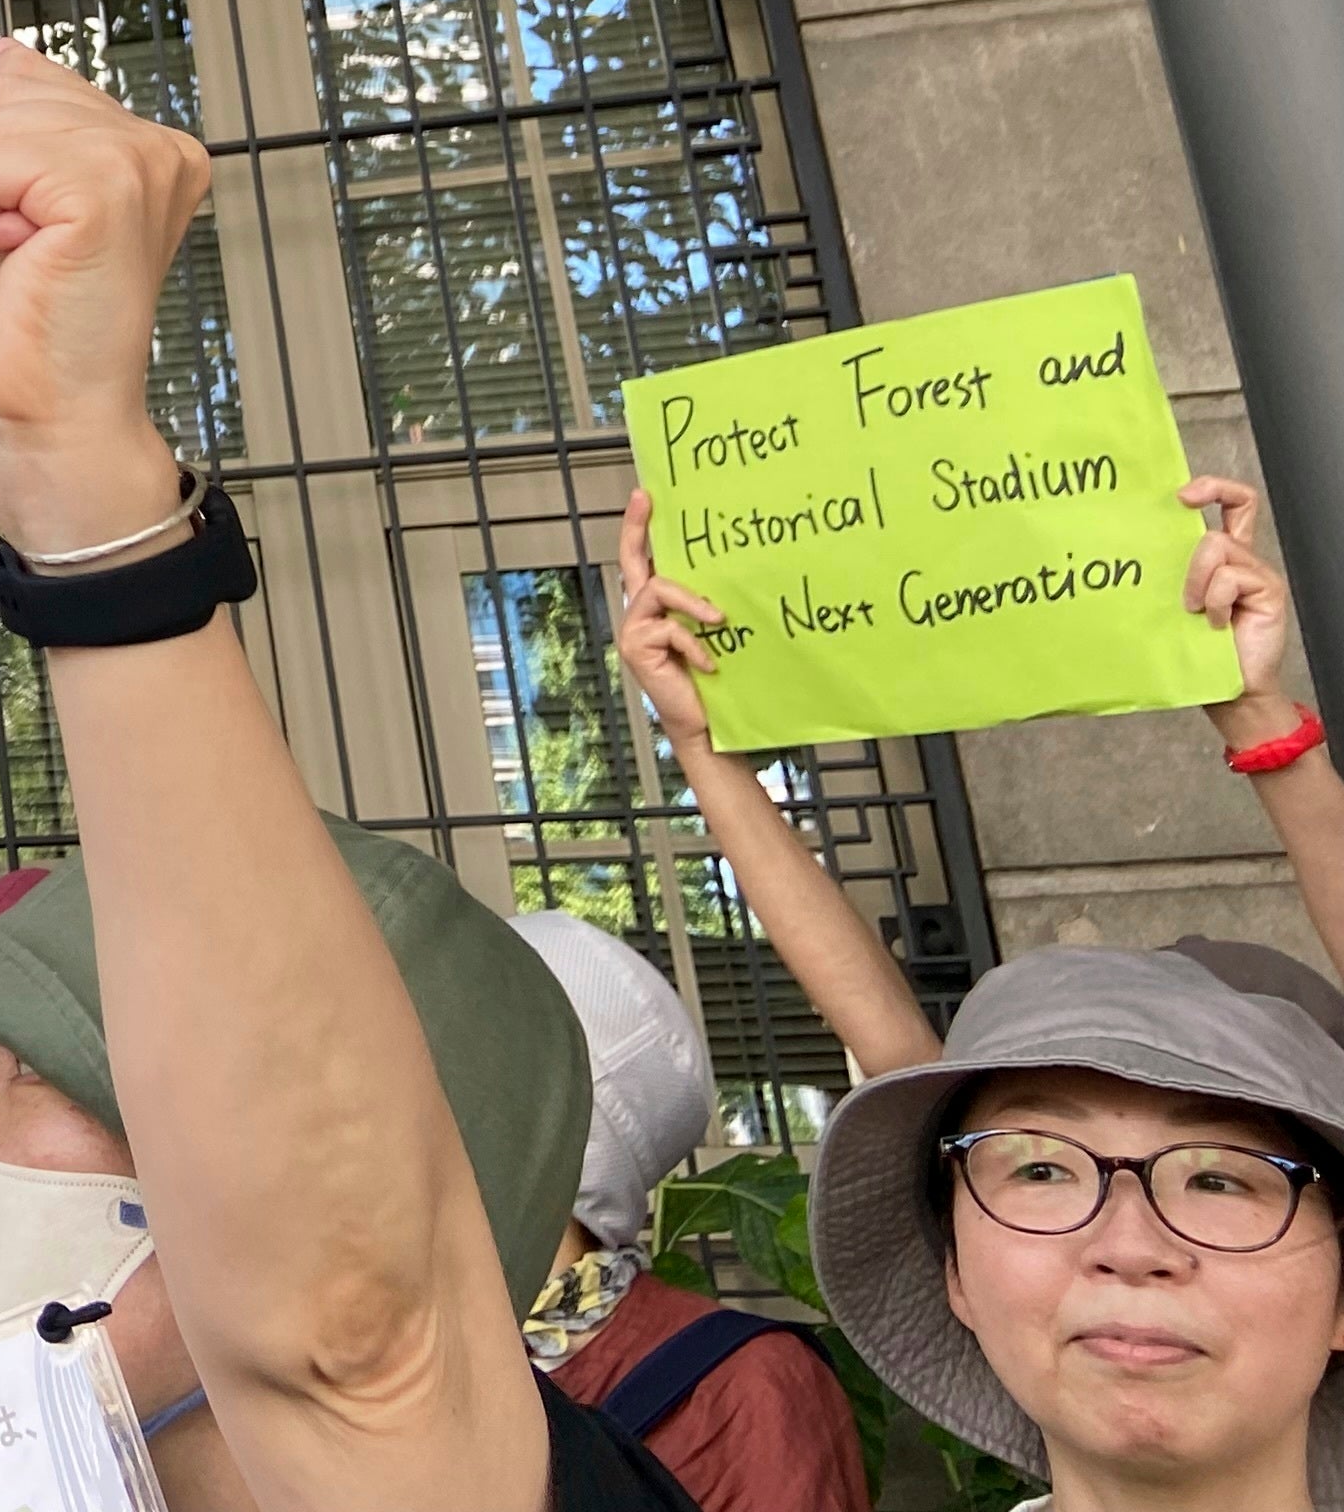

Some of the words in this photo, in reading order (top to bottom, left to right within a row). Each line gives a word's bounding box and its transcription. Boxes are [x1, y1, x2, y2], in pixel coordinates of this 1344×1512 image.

[661, 395, 800, 486] Protect
[842, 347, 993, 428] Forest
[1039, 332, 1125, 385] and
[681, 468, 885, 569] Historical
[931, 451, 1117, 512] Stadium
[780, 578, 874, 639] Next
[898, 552, 1142, 628] Generation
